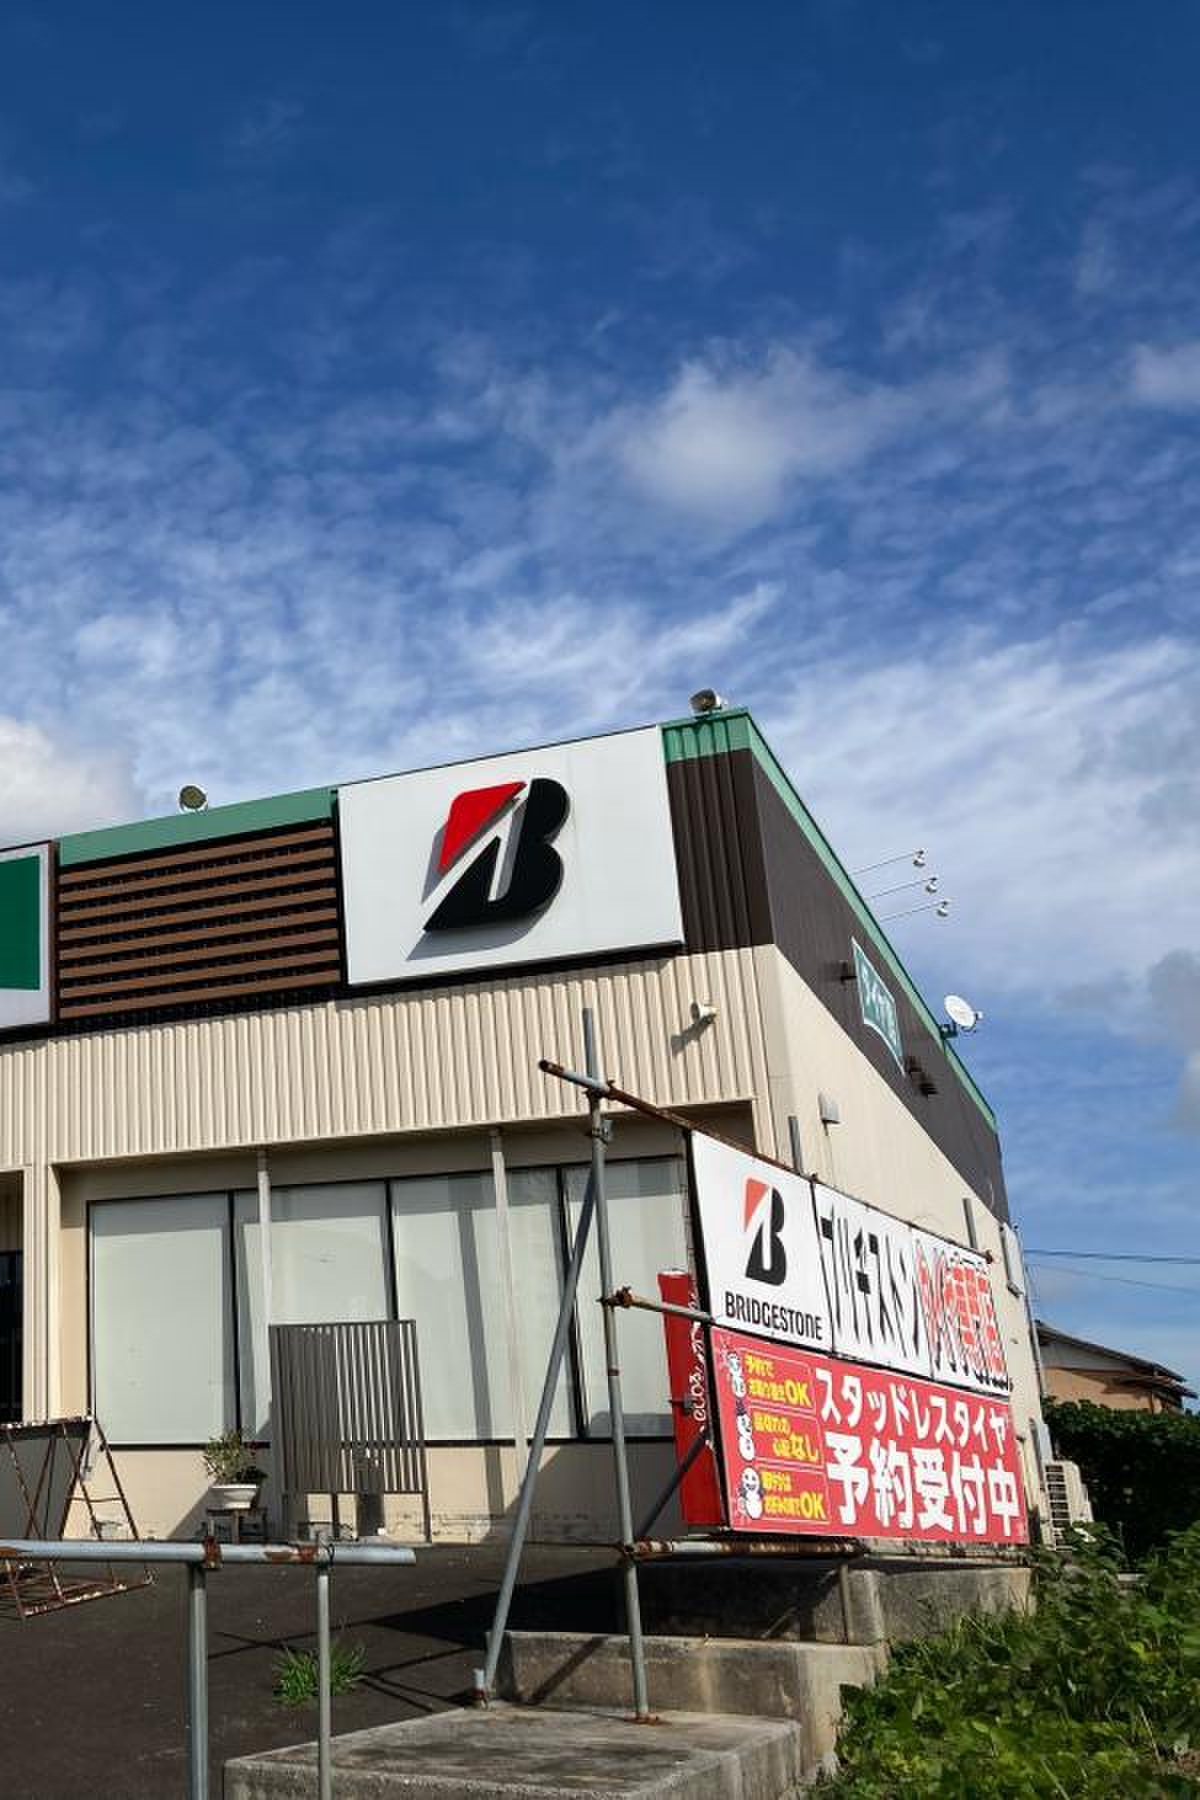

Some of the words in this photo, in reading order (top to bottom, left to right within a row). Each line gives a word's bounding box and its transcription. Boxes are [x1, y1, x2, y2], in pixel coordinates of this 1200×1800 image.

[724, 1290, 823, 1341] BRIDGESTONE
[815, 1367, 1007, 1455] スタッドレスタイヤ
[823, 1430, 1021, 1538] 予約受付中
